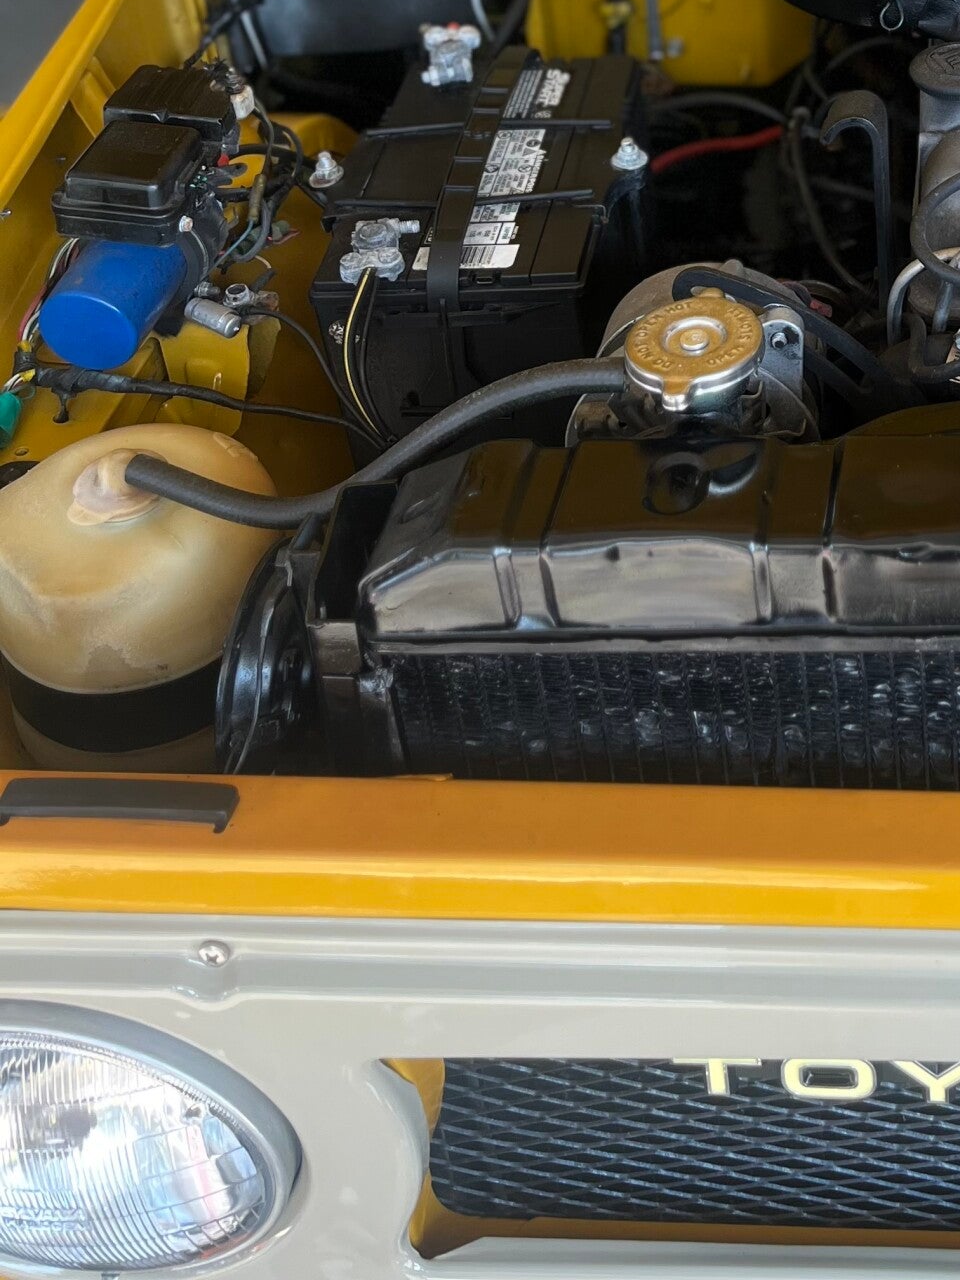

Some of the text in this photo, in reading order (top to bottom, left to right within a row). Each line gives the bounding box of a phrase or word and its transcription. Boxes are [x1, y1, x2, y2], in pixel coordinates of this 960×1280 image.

[536, 68, 561, 107] START
[635, 302, 692, 369] DO NOT OPEN HOT
[706, 347, 745, 366] OPEN
